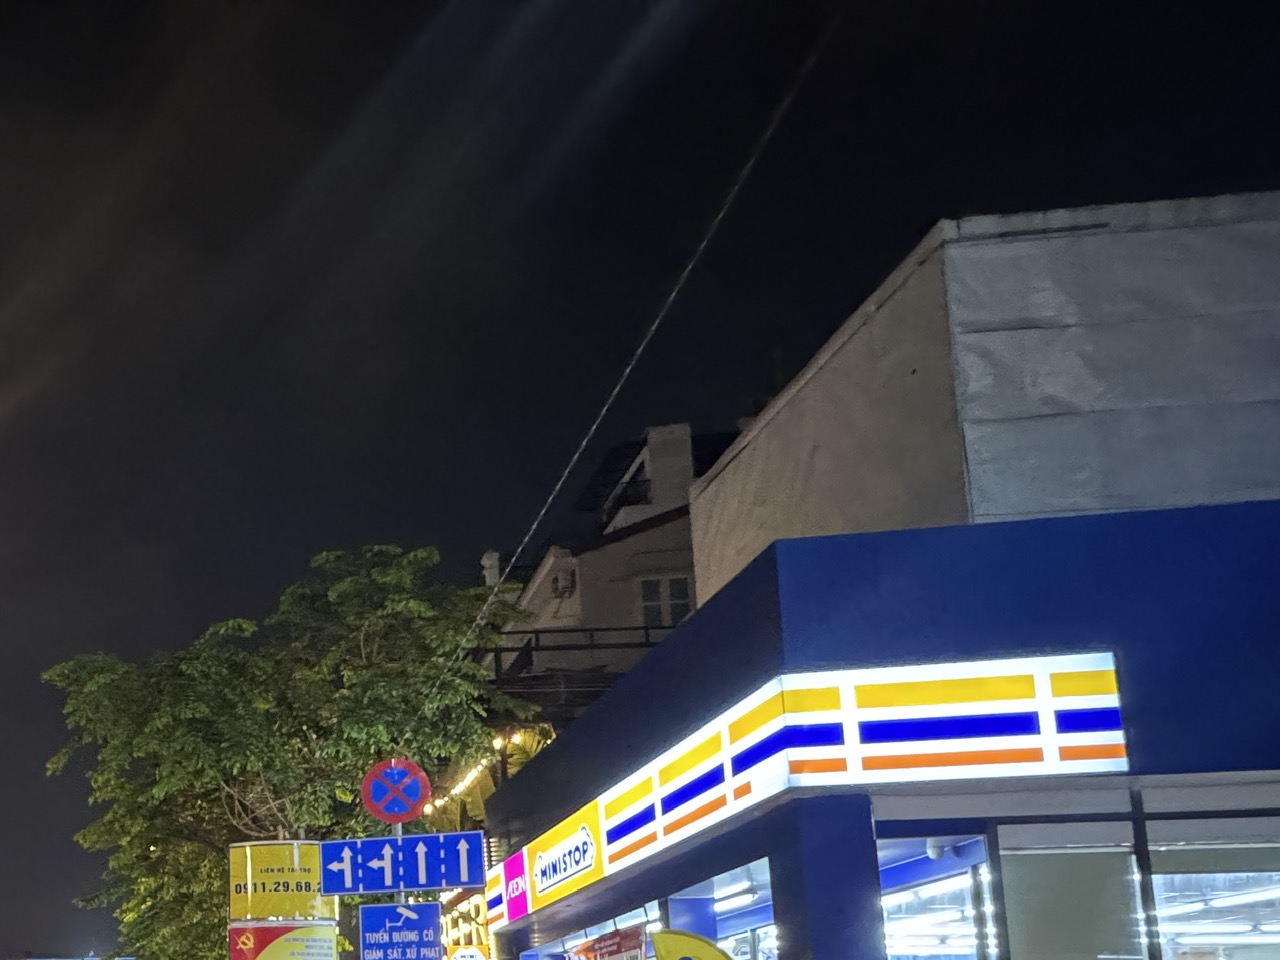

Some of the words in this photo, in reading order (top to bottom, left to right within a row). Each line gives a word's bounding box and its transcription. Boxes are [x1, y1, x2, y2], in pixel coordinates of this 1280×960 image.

[234, 881, 321, 895] 0911.29.68.
[364, 927, 389, 944] TUYẾN
[392, 927, 419, 943] ĐƯỜNG
[422, 926, 434, 941] CÓ
[364, 946, 384, 960] GIÁM
[421, 946, 441, 960] PHẠT
